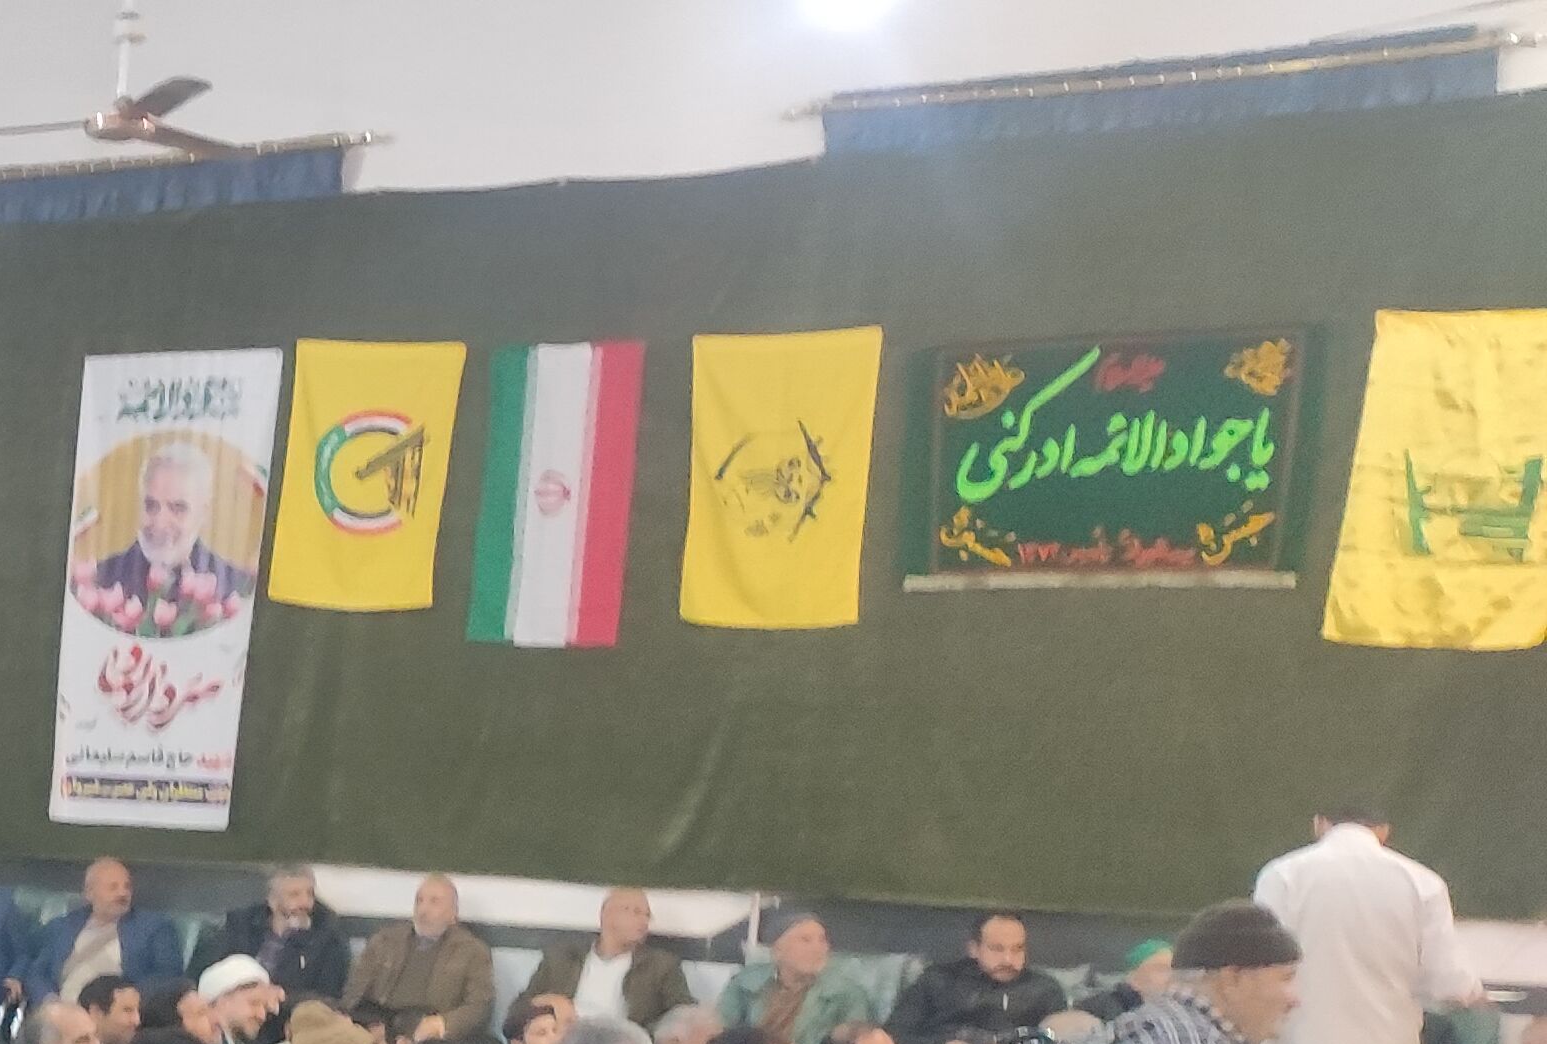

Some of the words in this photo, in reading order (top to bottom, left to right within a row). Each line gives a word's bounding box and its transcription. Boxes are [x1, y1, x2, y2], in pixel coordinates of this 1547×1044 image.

[955, 344, 1100, 503] ادرکنی
[1069, 408, 1168, 478] الائمه
[1163, 416, 1256, 484] جواد
[1247, 406, 1276, 492] یا
